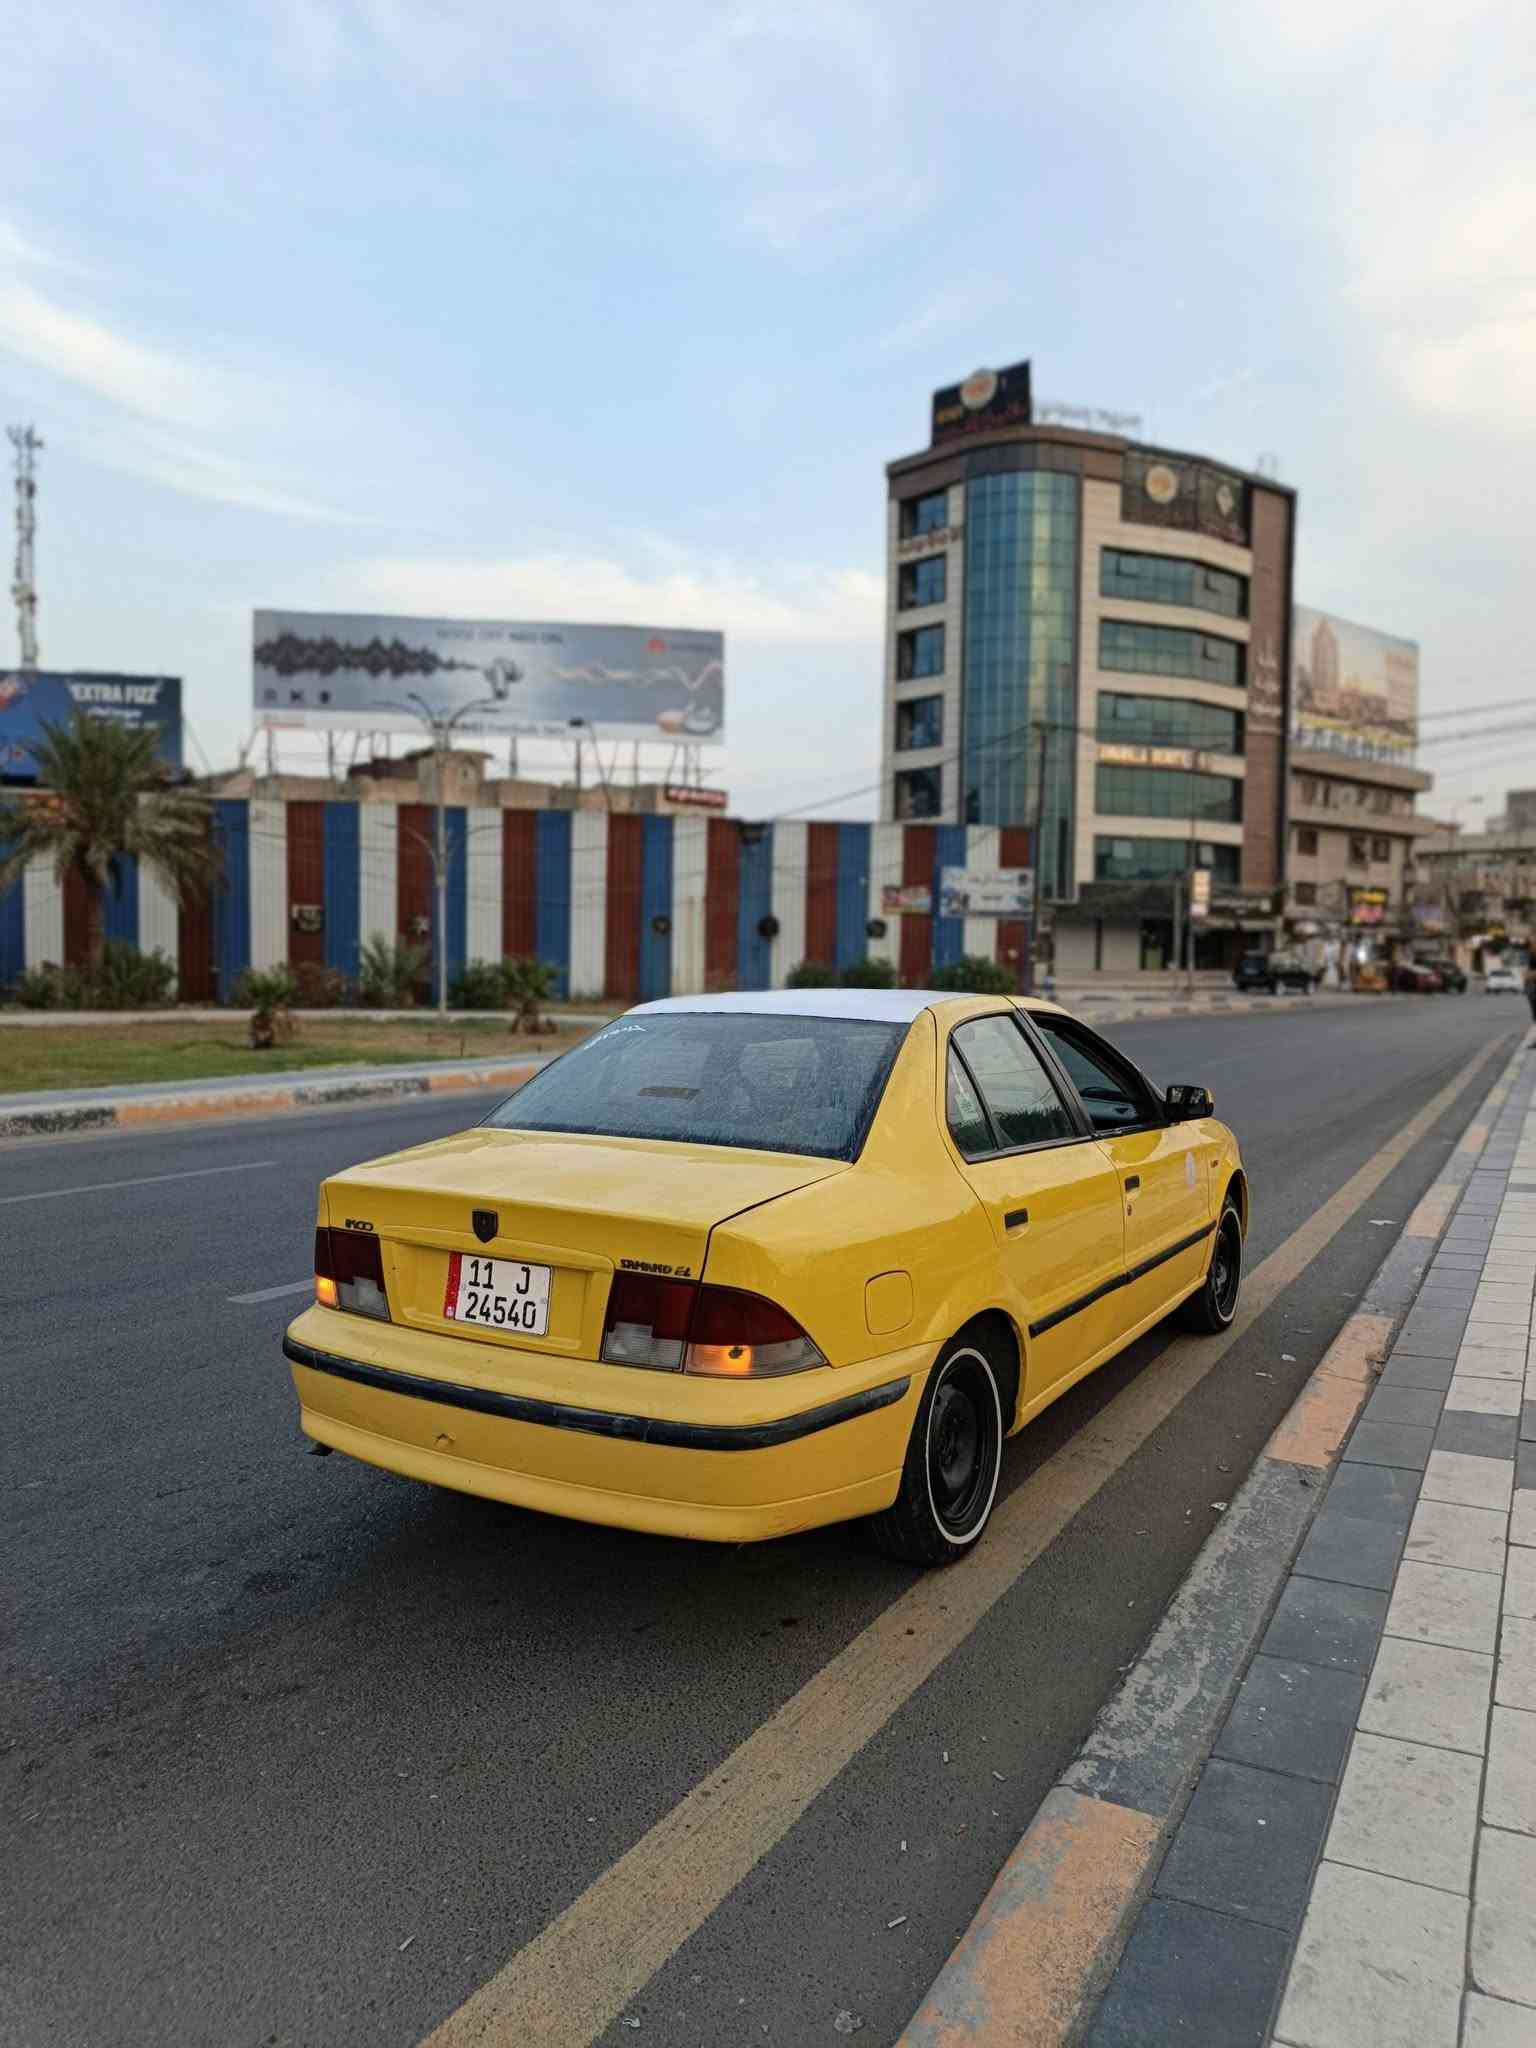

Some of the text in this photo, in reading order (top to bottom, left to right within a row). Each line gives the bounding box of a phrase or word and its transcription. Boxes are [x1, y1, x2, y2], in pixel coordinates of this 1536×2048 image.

[468, 1258, 531, 1295] 11 J
[620, 1258, 673, 1275] SAMAND
[465, 1291, 537, 1329] 24540
